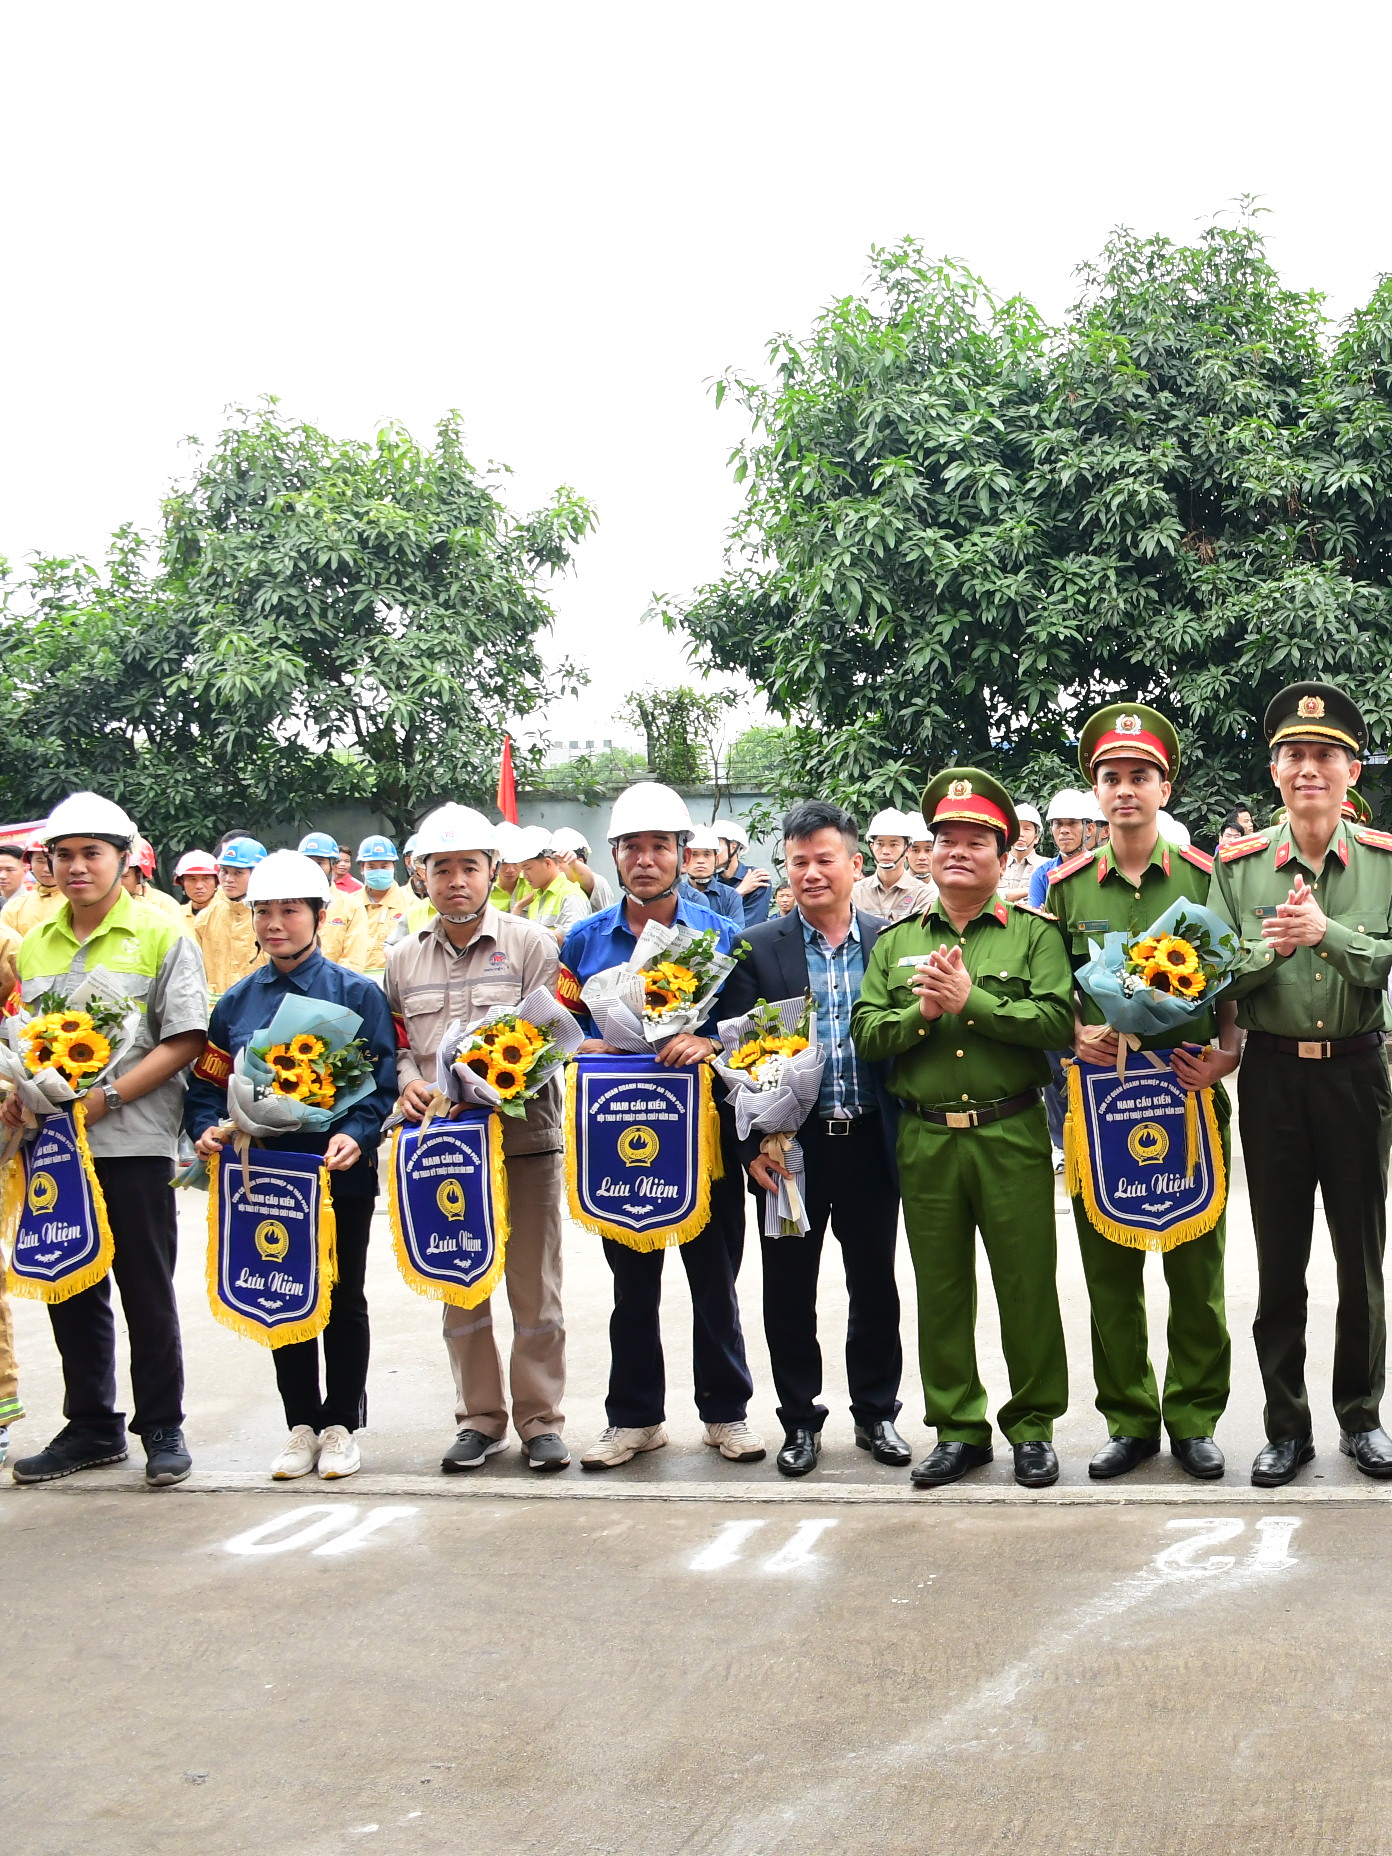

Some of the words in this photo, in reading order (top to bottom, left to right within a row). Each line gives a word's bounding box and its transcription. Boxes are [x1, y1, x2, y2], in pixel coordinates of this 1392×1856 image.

[610, 1102, 628, 1110] NAM
[1117, 1099, 1135, 1109] NAM
[596, 1176, 631, 1197] Lưu
[635, 1176, 679, 1203] Niệm
[1114, 1177, 1148, 1199] Lưu
[1151, 1173, 1195, 1197] Niệm
[17, 1228, 40, 1250] Lưu
[42, 1222, 81, 1246] Niệm
[426, 1233, 458, 1255] Lưu
[235, 1268, 265, 1289] Lưu
[268, 1271, 303, 1300] Niệm
[225, 1504, 421, 1557] 10
[689, 1517, 838, 1573] 11
[1155, 1515, 1303, 1575] 12
